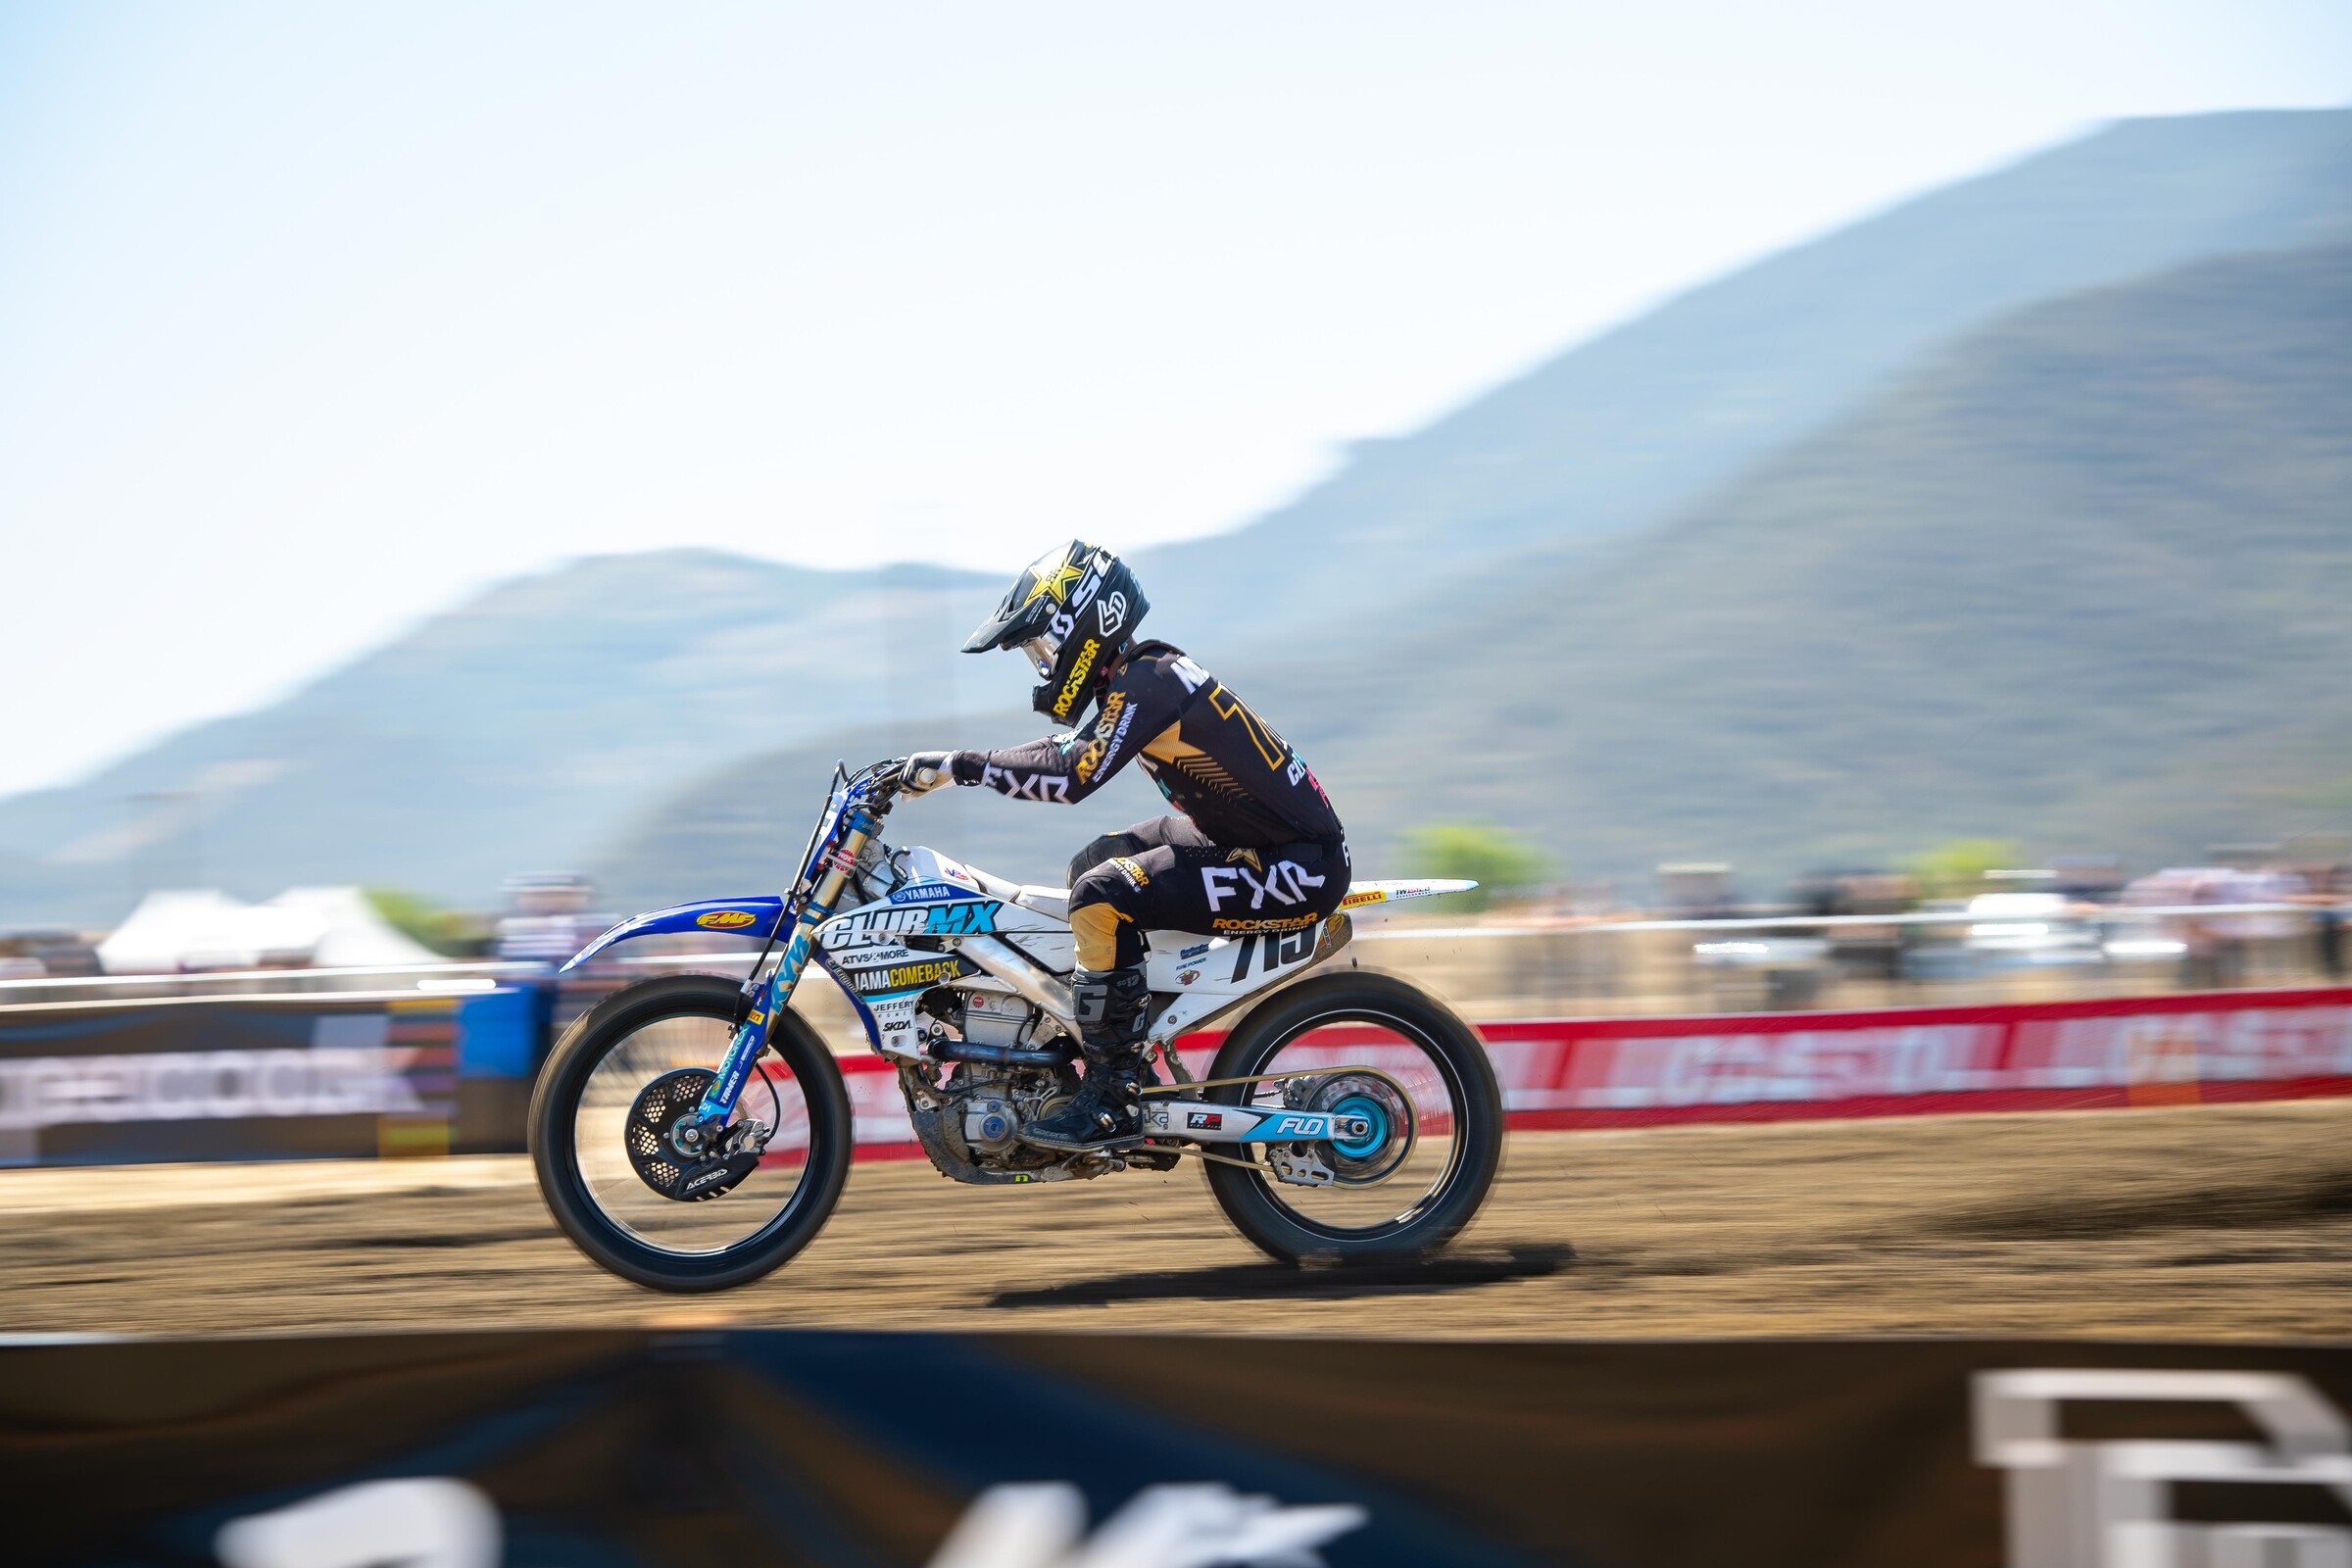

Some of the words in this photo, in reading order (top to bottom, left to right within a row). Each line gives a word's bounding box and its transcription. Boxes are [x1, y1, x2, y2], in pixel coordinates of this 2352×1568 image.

[1053, 639, 1101, 717] ROCKSTAR
[1116, 702, 1139, 737] DRINK
[1076, 691, 1127, 786] ROCKSTAR
[905, 887, 951, 901] YAMAHA
[1200, 860, 1325, 912] FXR
[1343, 891, 1383, 906] PIRELLI
[697, 911, 757, 925] FMF
[1212, 911, 1319, 930] ROCKSTAR
[1271, 924, 1309, 933] DRINK
[874, 1001, 914, 1011] JEFFERY
[717, 1028, 748, 1080] MOTOREX
[1276, 1116, 1325, 1136] FLO
[686, 1168, 728, 1191] ACERBIS
